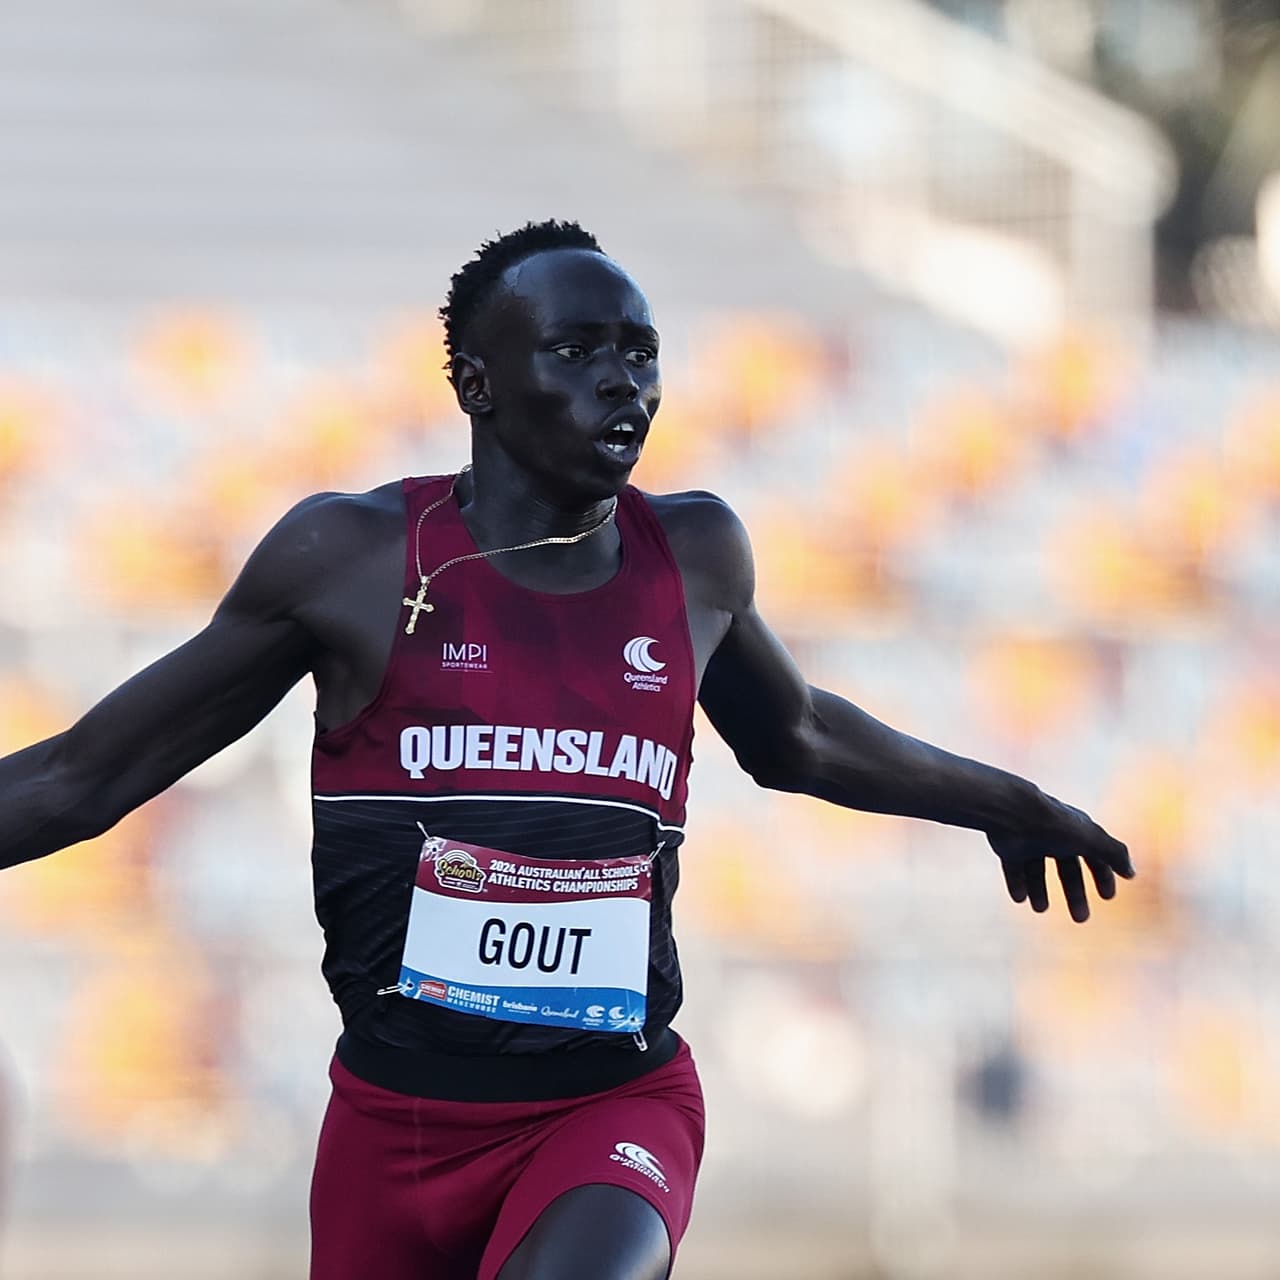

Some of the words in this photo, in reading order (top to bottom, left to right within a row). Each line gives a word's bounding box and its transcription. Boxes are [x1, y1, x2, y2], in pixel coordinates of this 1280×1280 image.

[442, 642, 487, 662] IMPI
[441, 661, 488, 669] SPORTSWEAR
[623, 672, 669, 685] Queensland
[399, 724, 677, 800] QUEENSLAND
[489, 859, 516, 874] 2024
[517, 864, 582, 880] AUSTRALIAN
[583, 869, 601, 879] ALL
[601, 864, 640, 879] SCHOOLS
[487, 872, 551, 892] ATHLETICS
[552, 878, 638, 893] CHAMPIONSHIPS
[478, 918, 592, 975] GOUT
[447, 985, 500, 1007] CHEMIST
